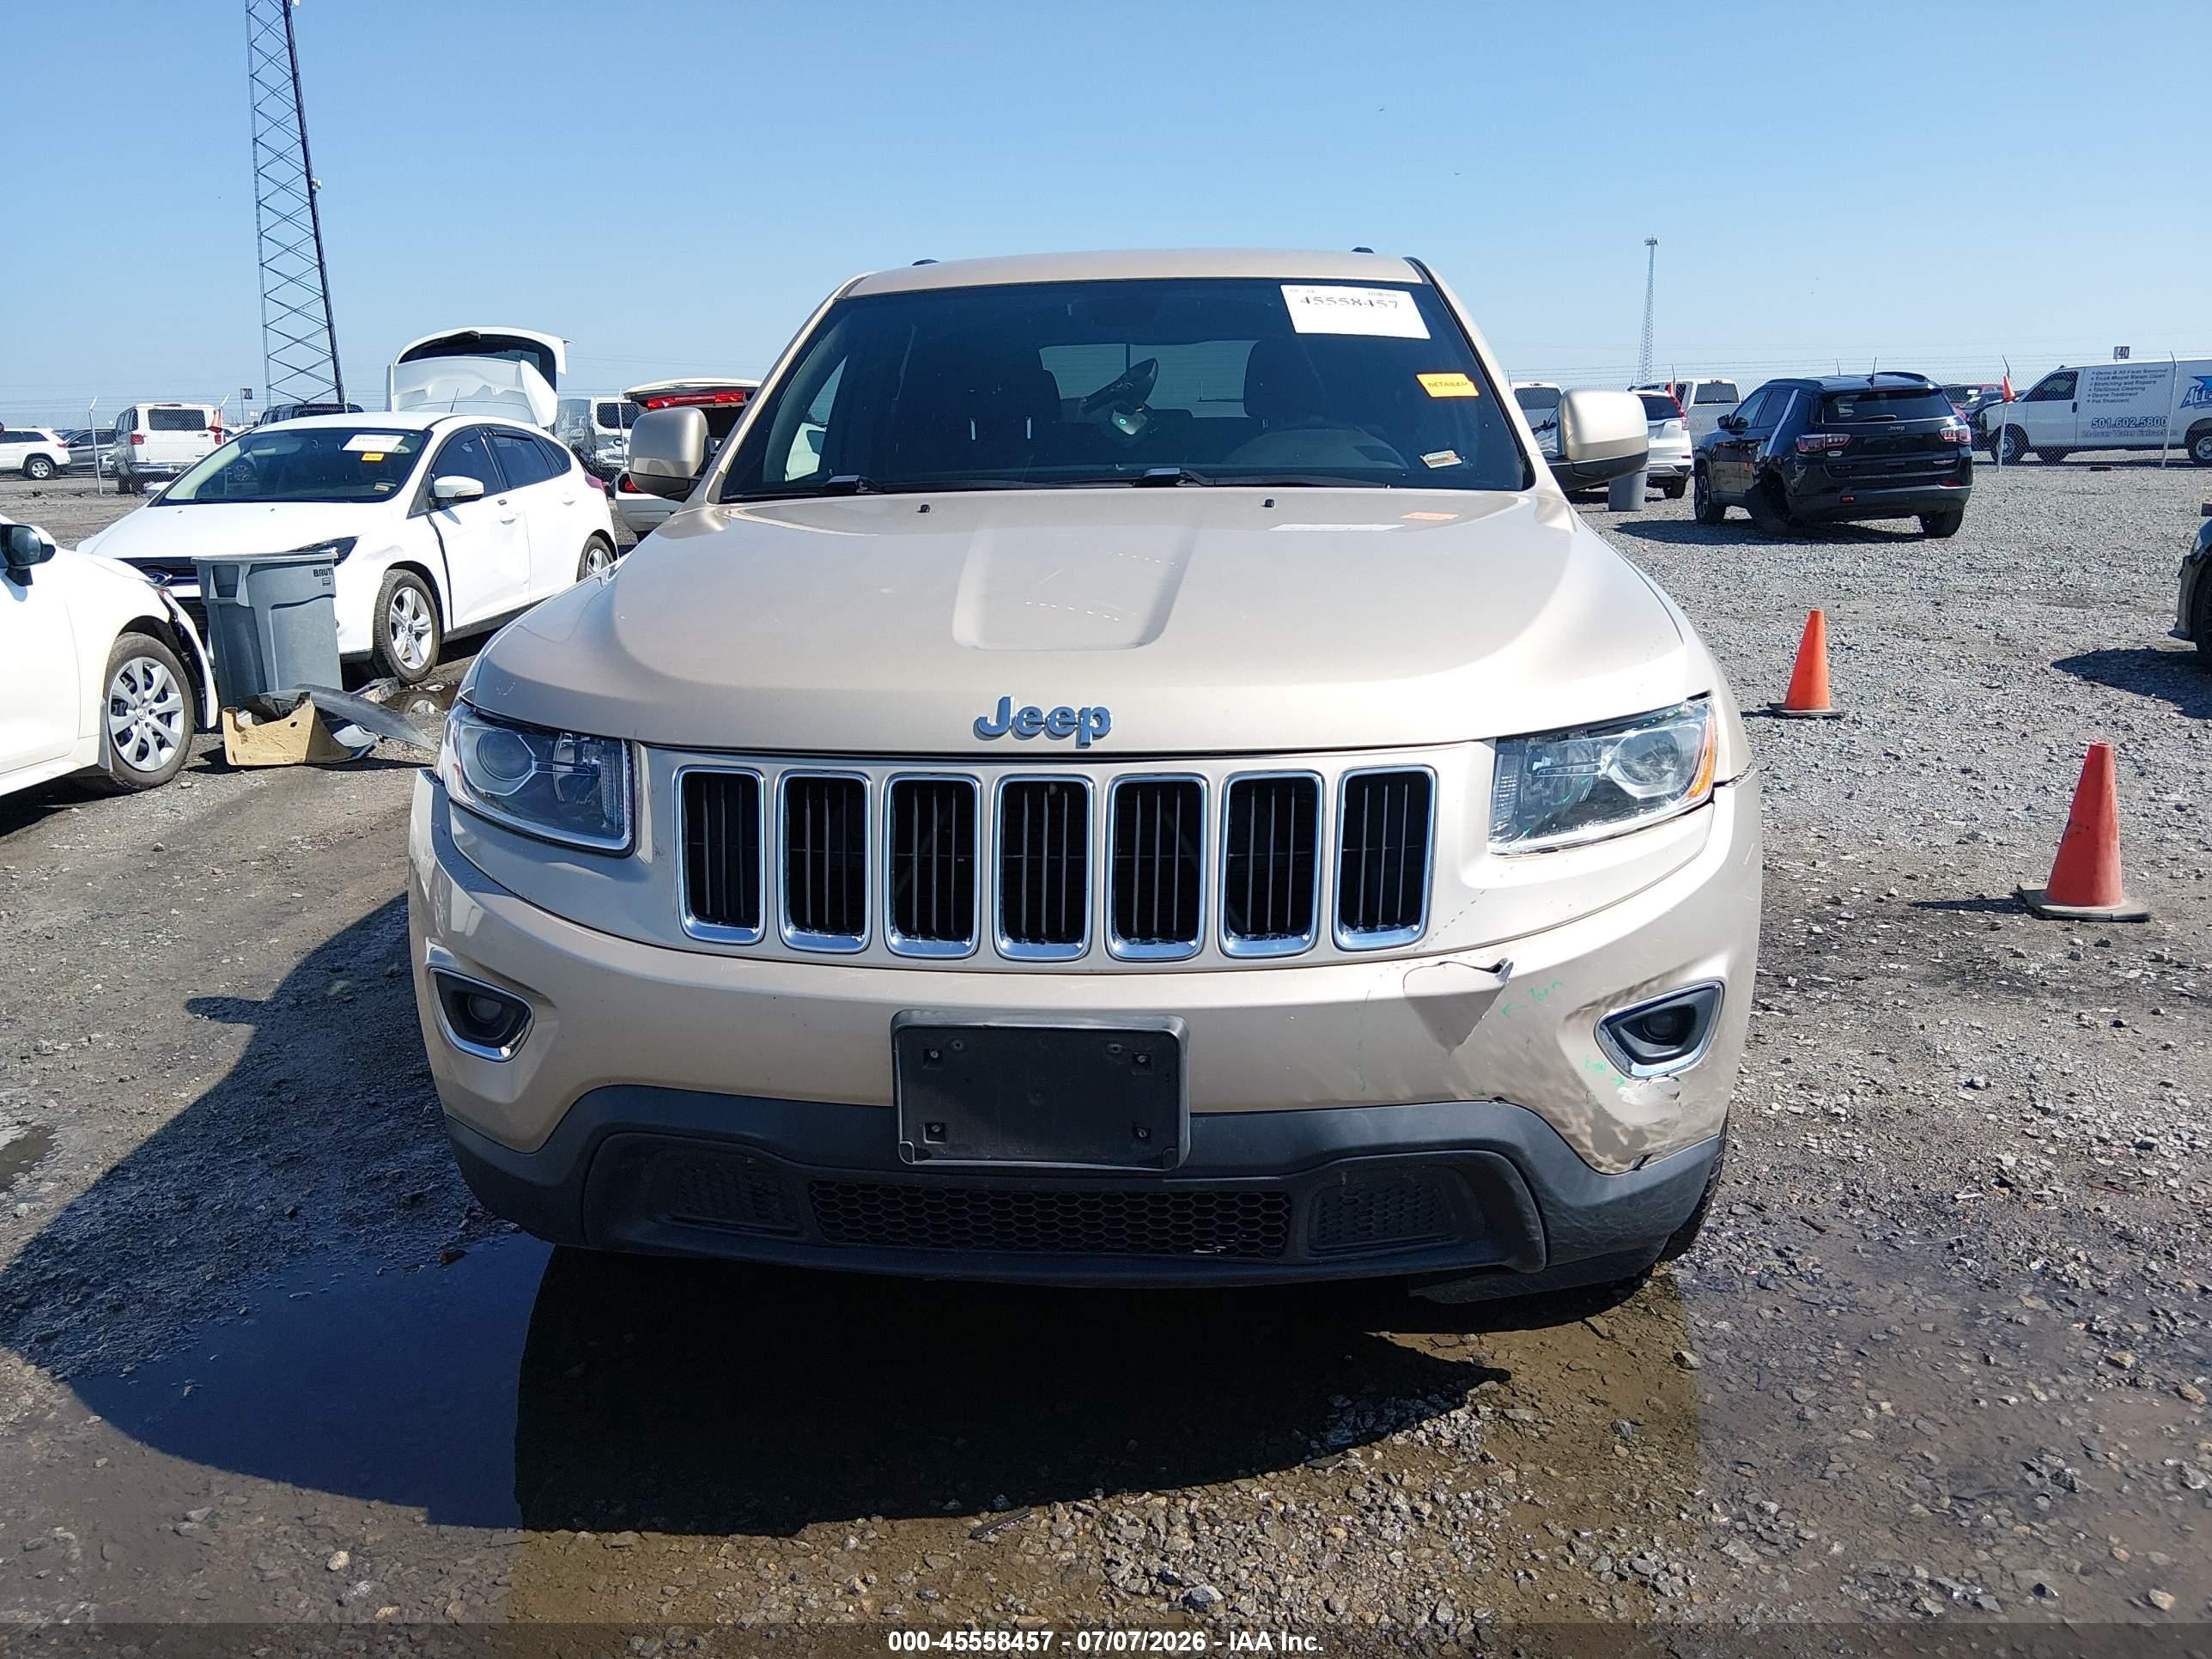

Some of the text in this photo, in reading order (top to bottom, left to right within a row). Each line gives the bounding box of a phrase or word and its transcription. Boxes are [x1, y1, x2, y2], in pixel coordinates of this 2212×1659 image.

[1300, 295, 1399, 309] 45558457
[2118, 347, 2130, 359] 40
[2091, 416, 2168, 428] 501.602.5800
[974, 696, 1112, 748] Jeep
